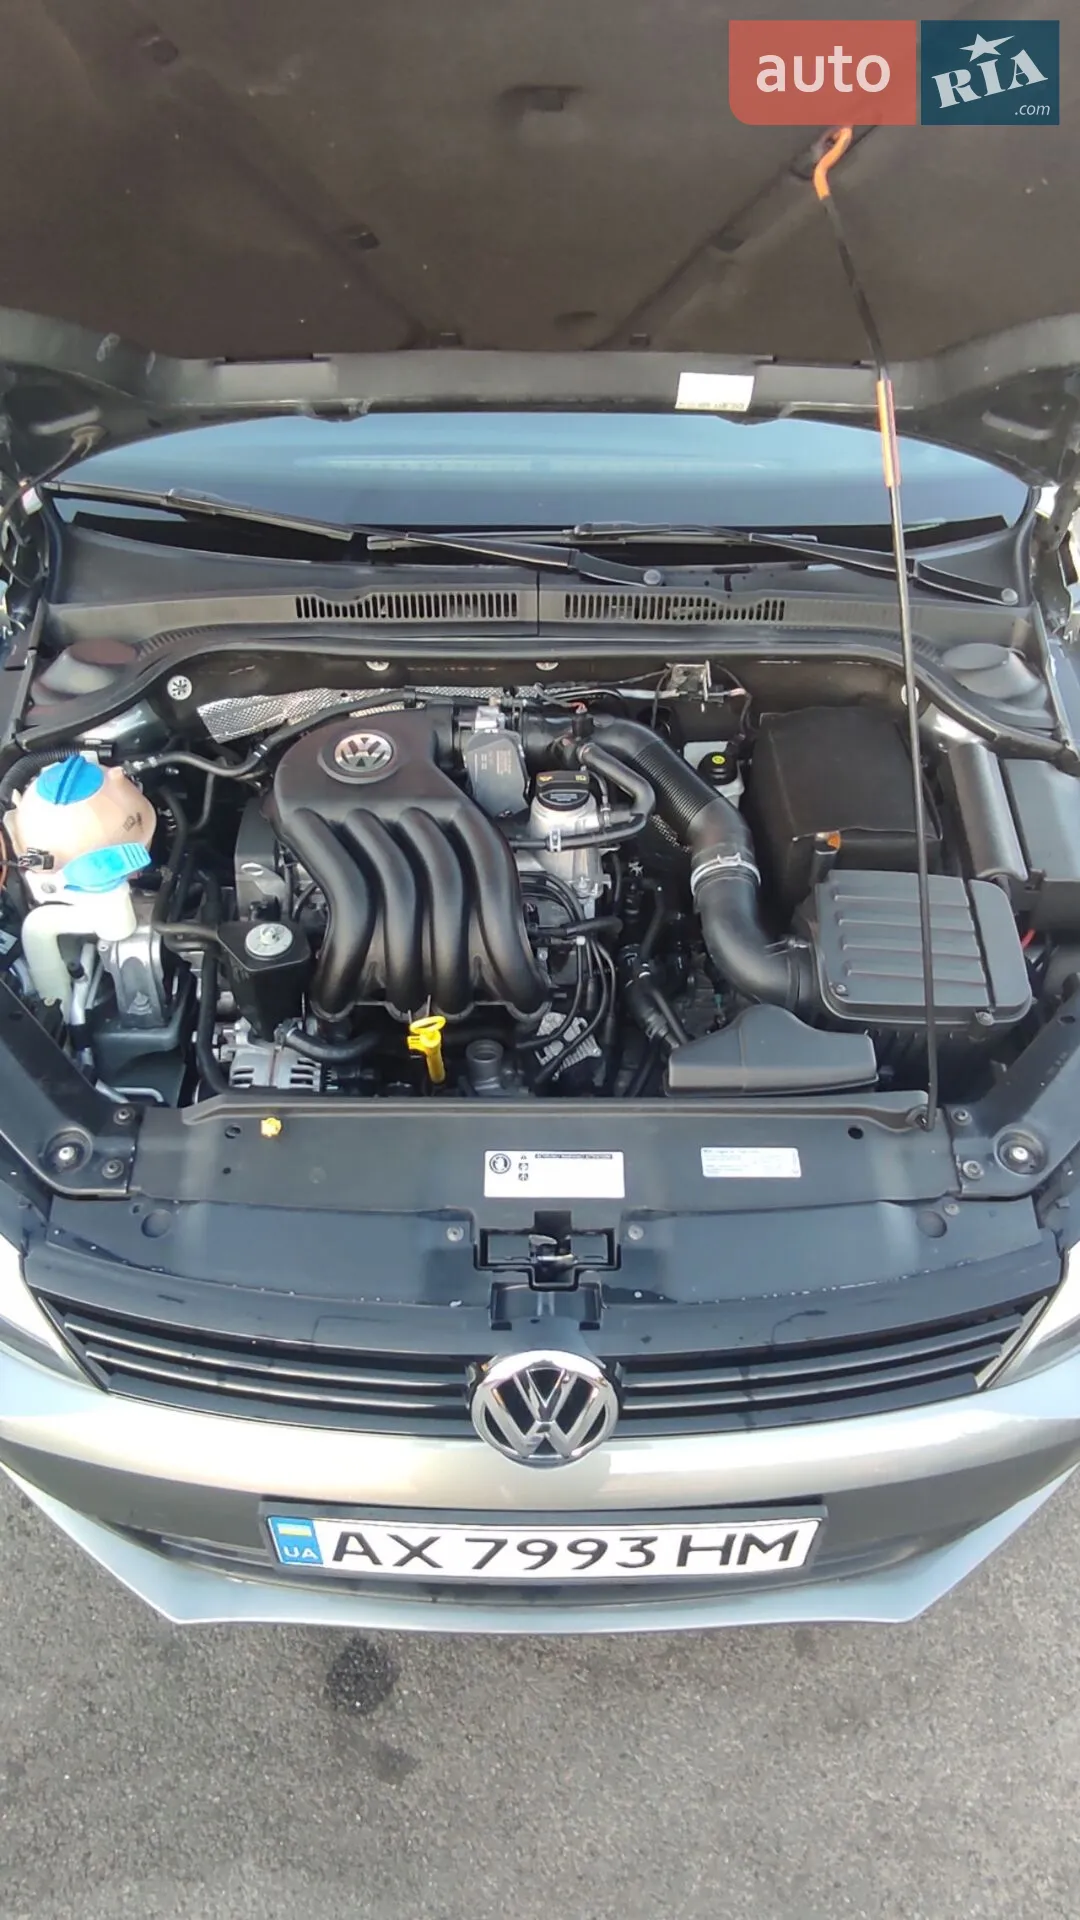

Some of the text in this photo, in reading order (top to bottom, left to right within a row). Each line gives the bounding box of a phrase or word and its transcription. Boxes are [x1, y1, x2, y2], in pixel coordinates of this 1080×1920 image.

[474, 1353, 616, 1466] VW
[283, 1545, 319, 1560] UA
[332, 1529, 798, 1571] AX 7993 HM
